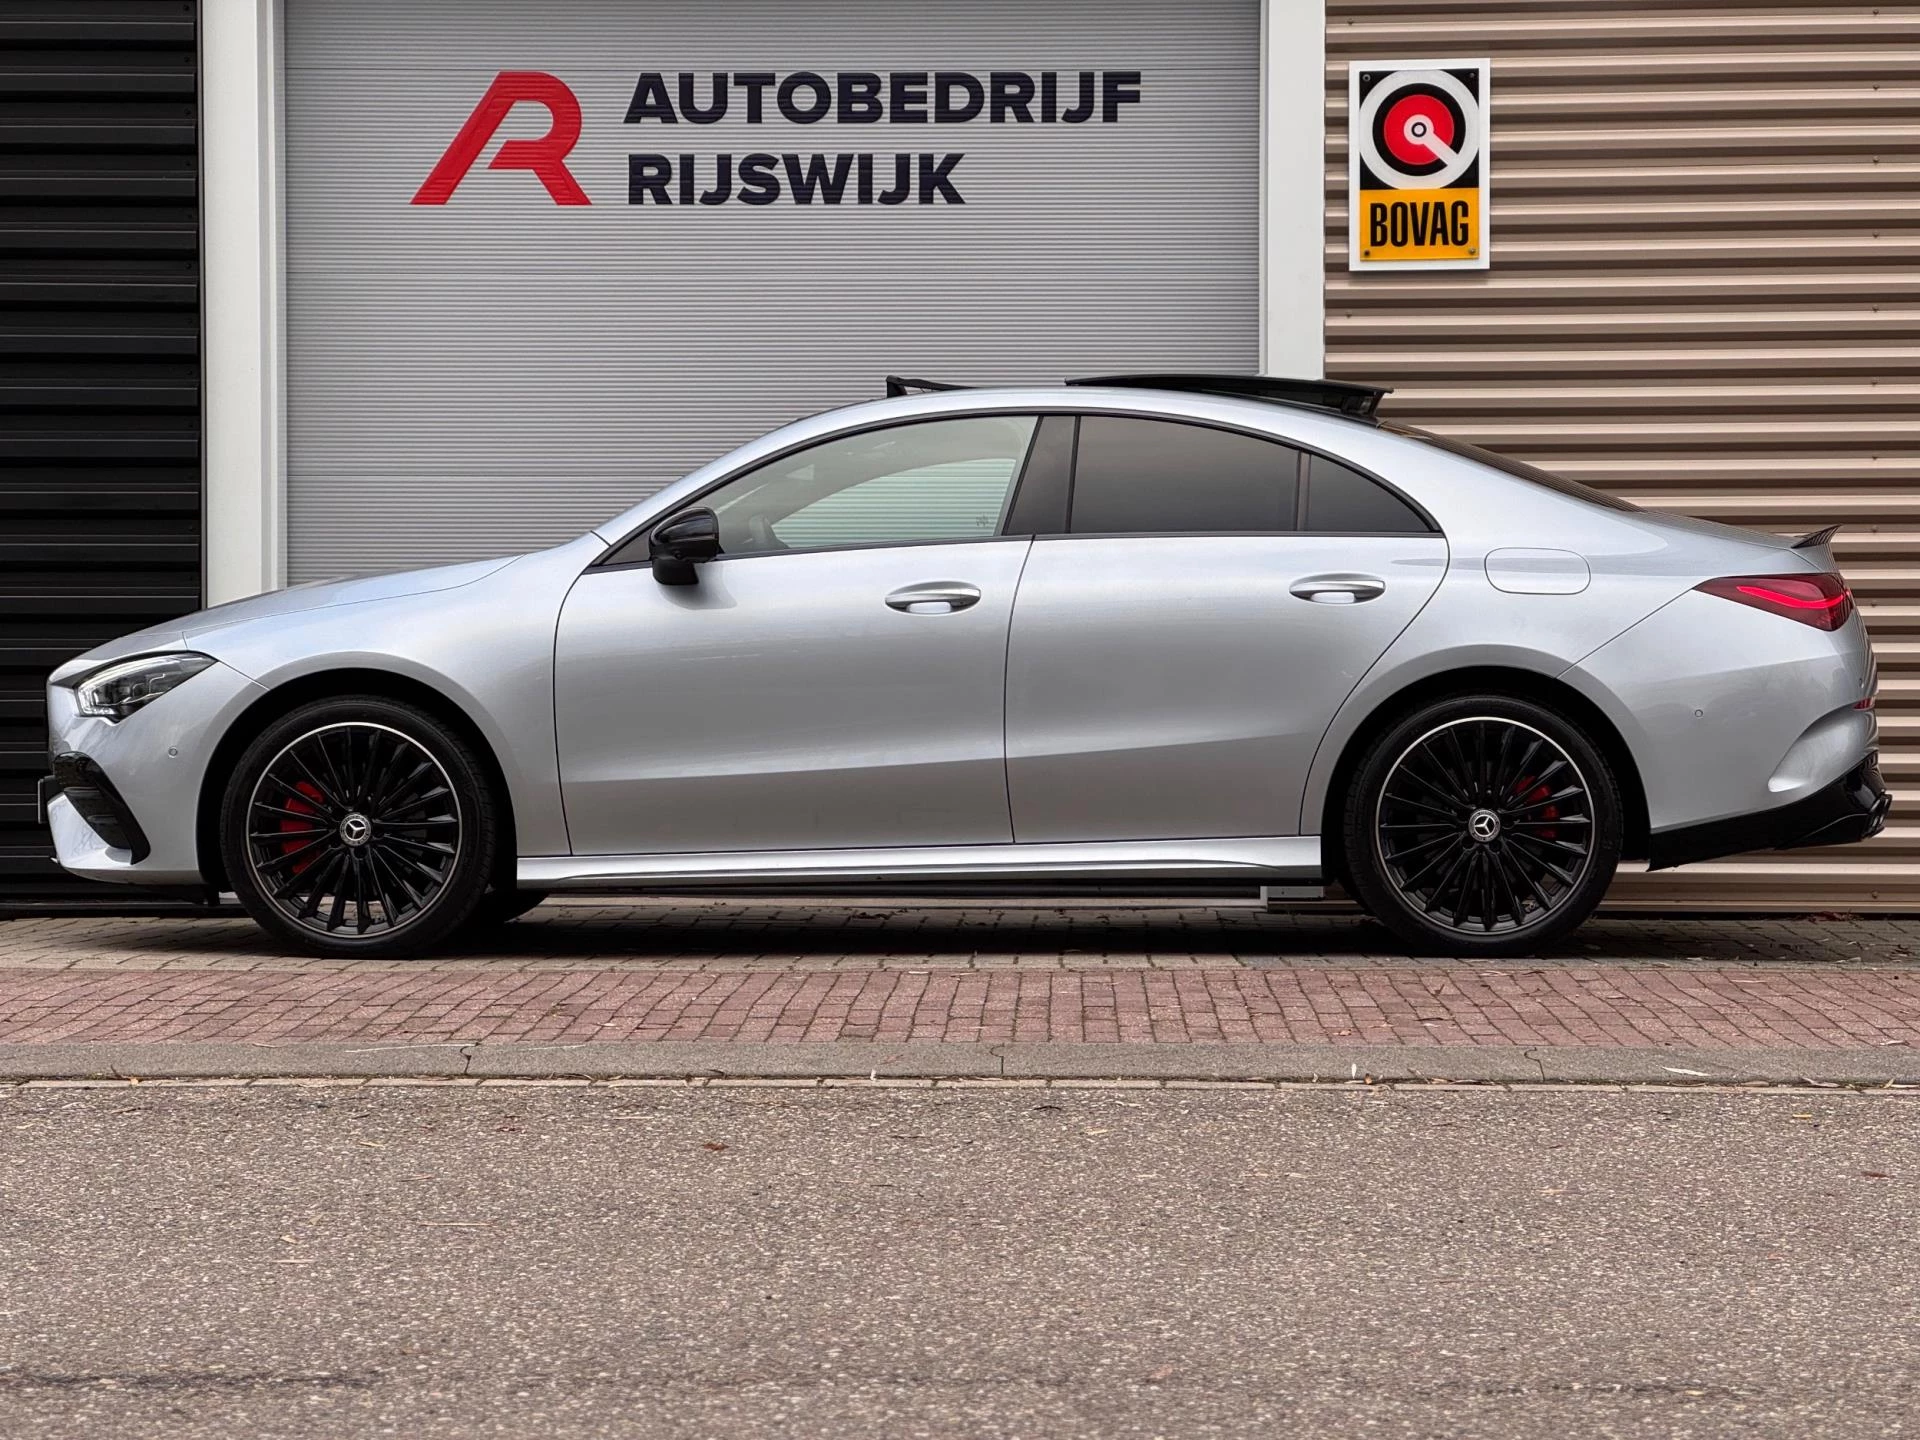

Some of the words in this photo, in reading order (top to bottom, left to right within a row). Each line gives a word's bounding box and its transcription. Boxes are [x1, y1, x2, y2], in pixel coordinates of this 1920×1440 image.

[624, 71, 1142, 125] AUTOBEDRIJF
[628, 153, 965, 206] RIJSWIJK
[1370, 200, 1469, 247] BOVAG
